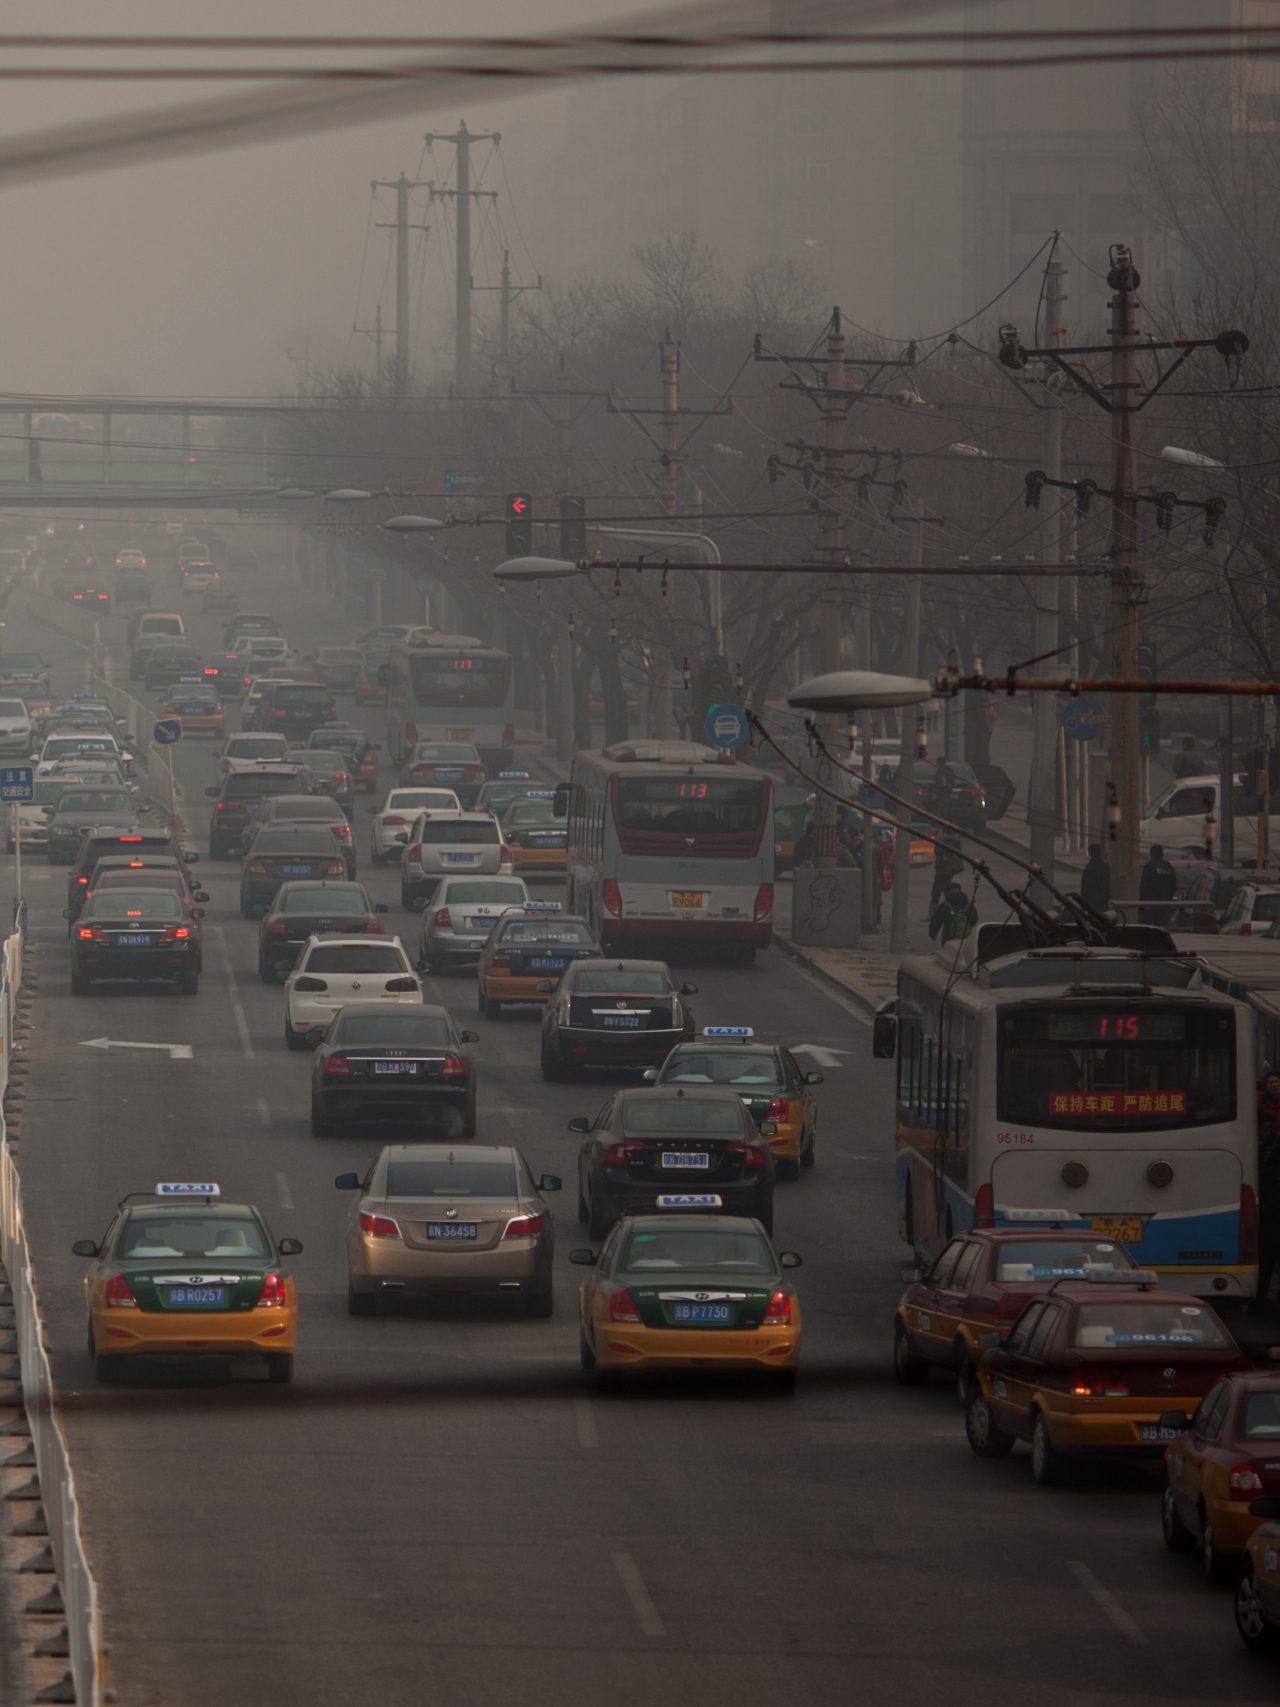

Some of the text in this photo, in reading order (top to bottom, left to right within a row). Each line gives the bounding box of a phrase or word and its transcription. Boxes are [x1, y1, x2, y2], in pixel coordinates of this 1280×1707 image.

[679, 784, 708, 798] 113
[1099, 1018, 1139, 1040] 115
[1054, 1096, 1185, 1112] 保持车距 严防追尾
[997, 1133, 1034, 1144] 95184
[166, 1184, 212, 1192] TAXI
[666, 1196, 713, 1204] TAXI
